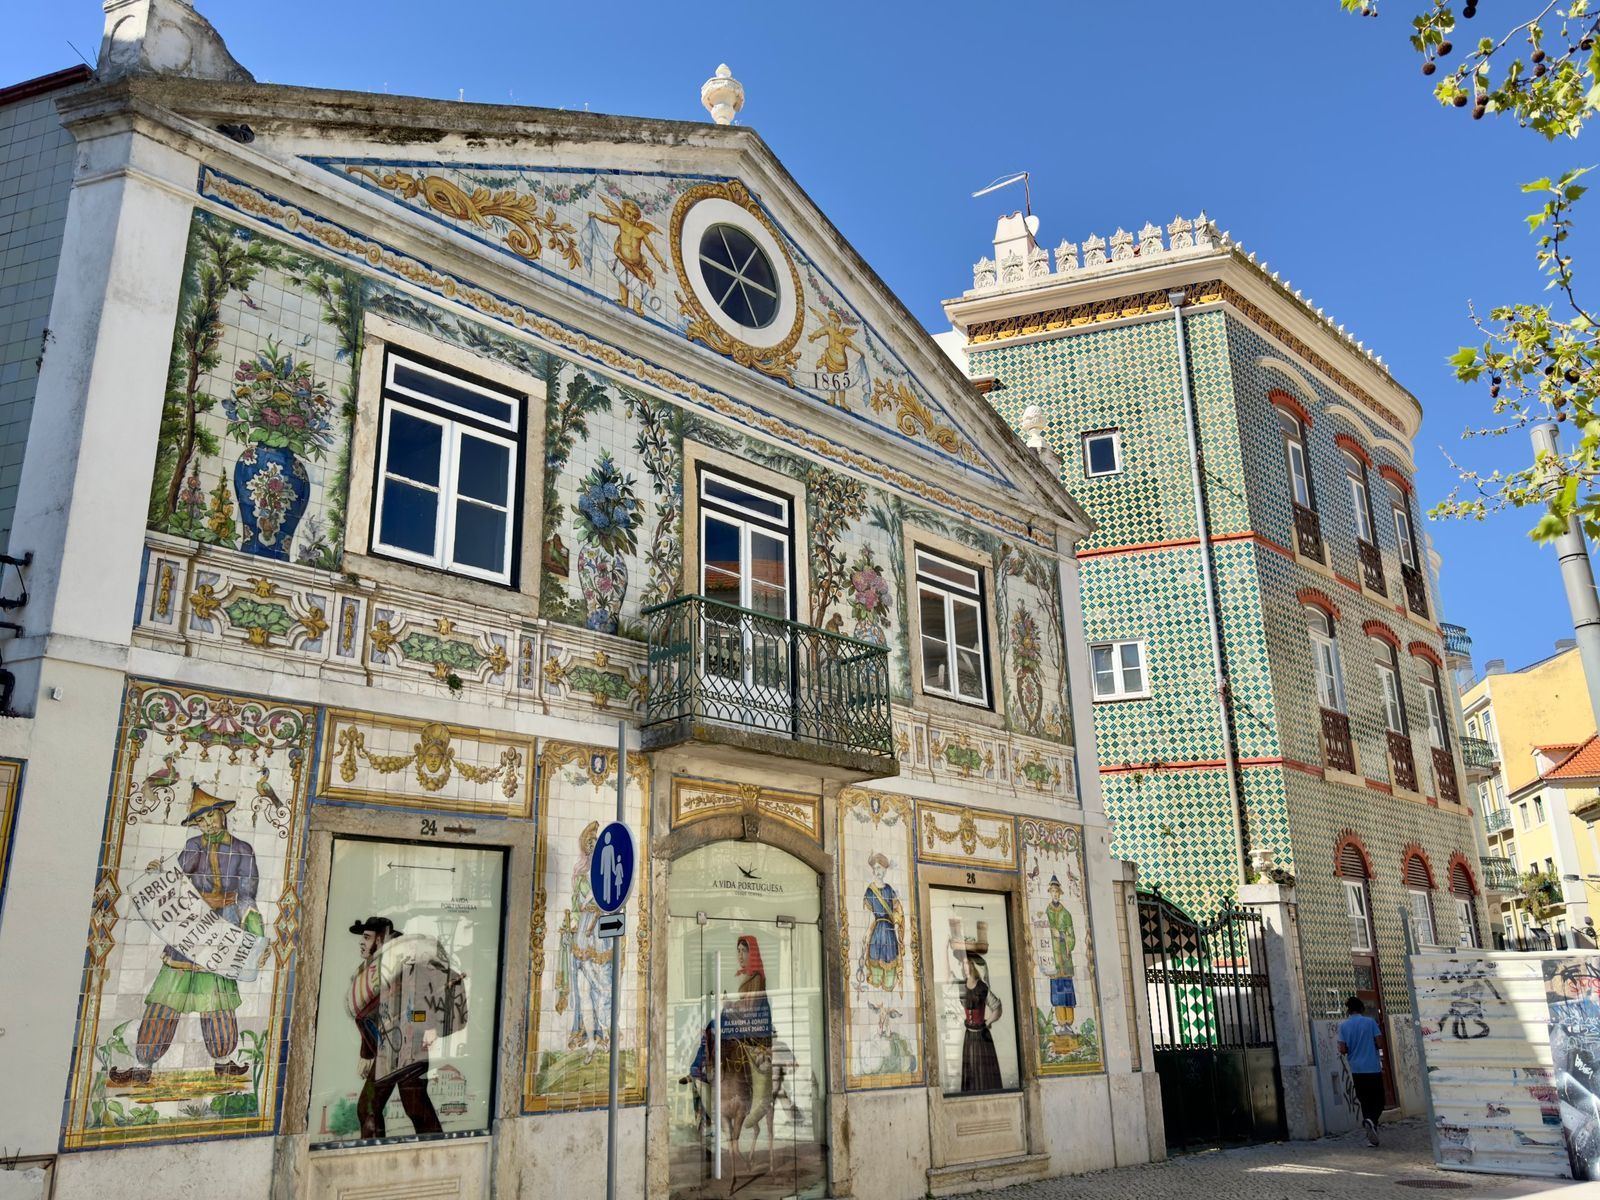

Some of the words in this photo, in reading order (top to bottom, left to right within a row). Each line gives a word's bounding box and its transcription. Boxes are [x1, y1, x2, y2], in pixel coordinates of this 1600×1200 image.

[813, 372, 851, 390] 1865
[420, 818, 438, 836] 24
[712, 880, 718, 888] A
[719, 880, 736, 889] VIDA
[738, 881, 784, 893] PORTUGUESA
[966, 872, 976, 885] 26
[158, 887, 176, 908] DE
[151, 890, 200, 932] LOIÇA
[178, 912, 199, 930] DE
[178, 910, 220, 956] ANTONIO
[206, 927, 242, 972] COSTA
[225, 932, 257, 980] LAMEGO
